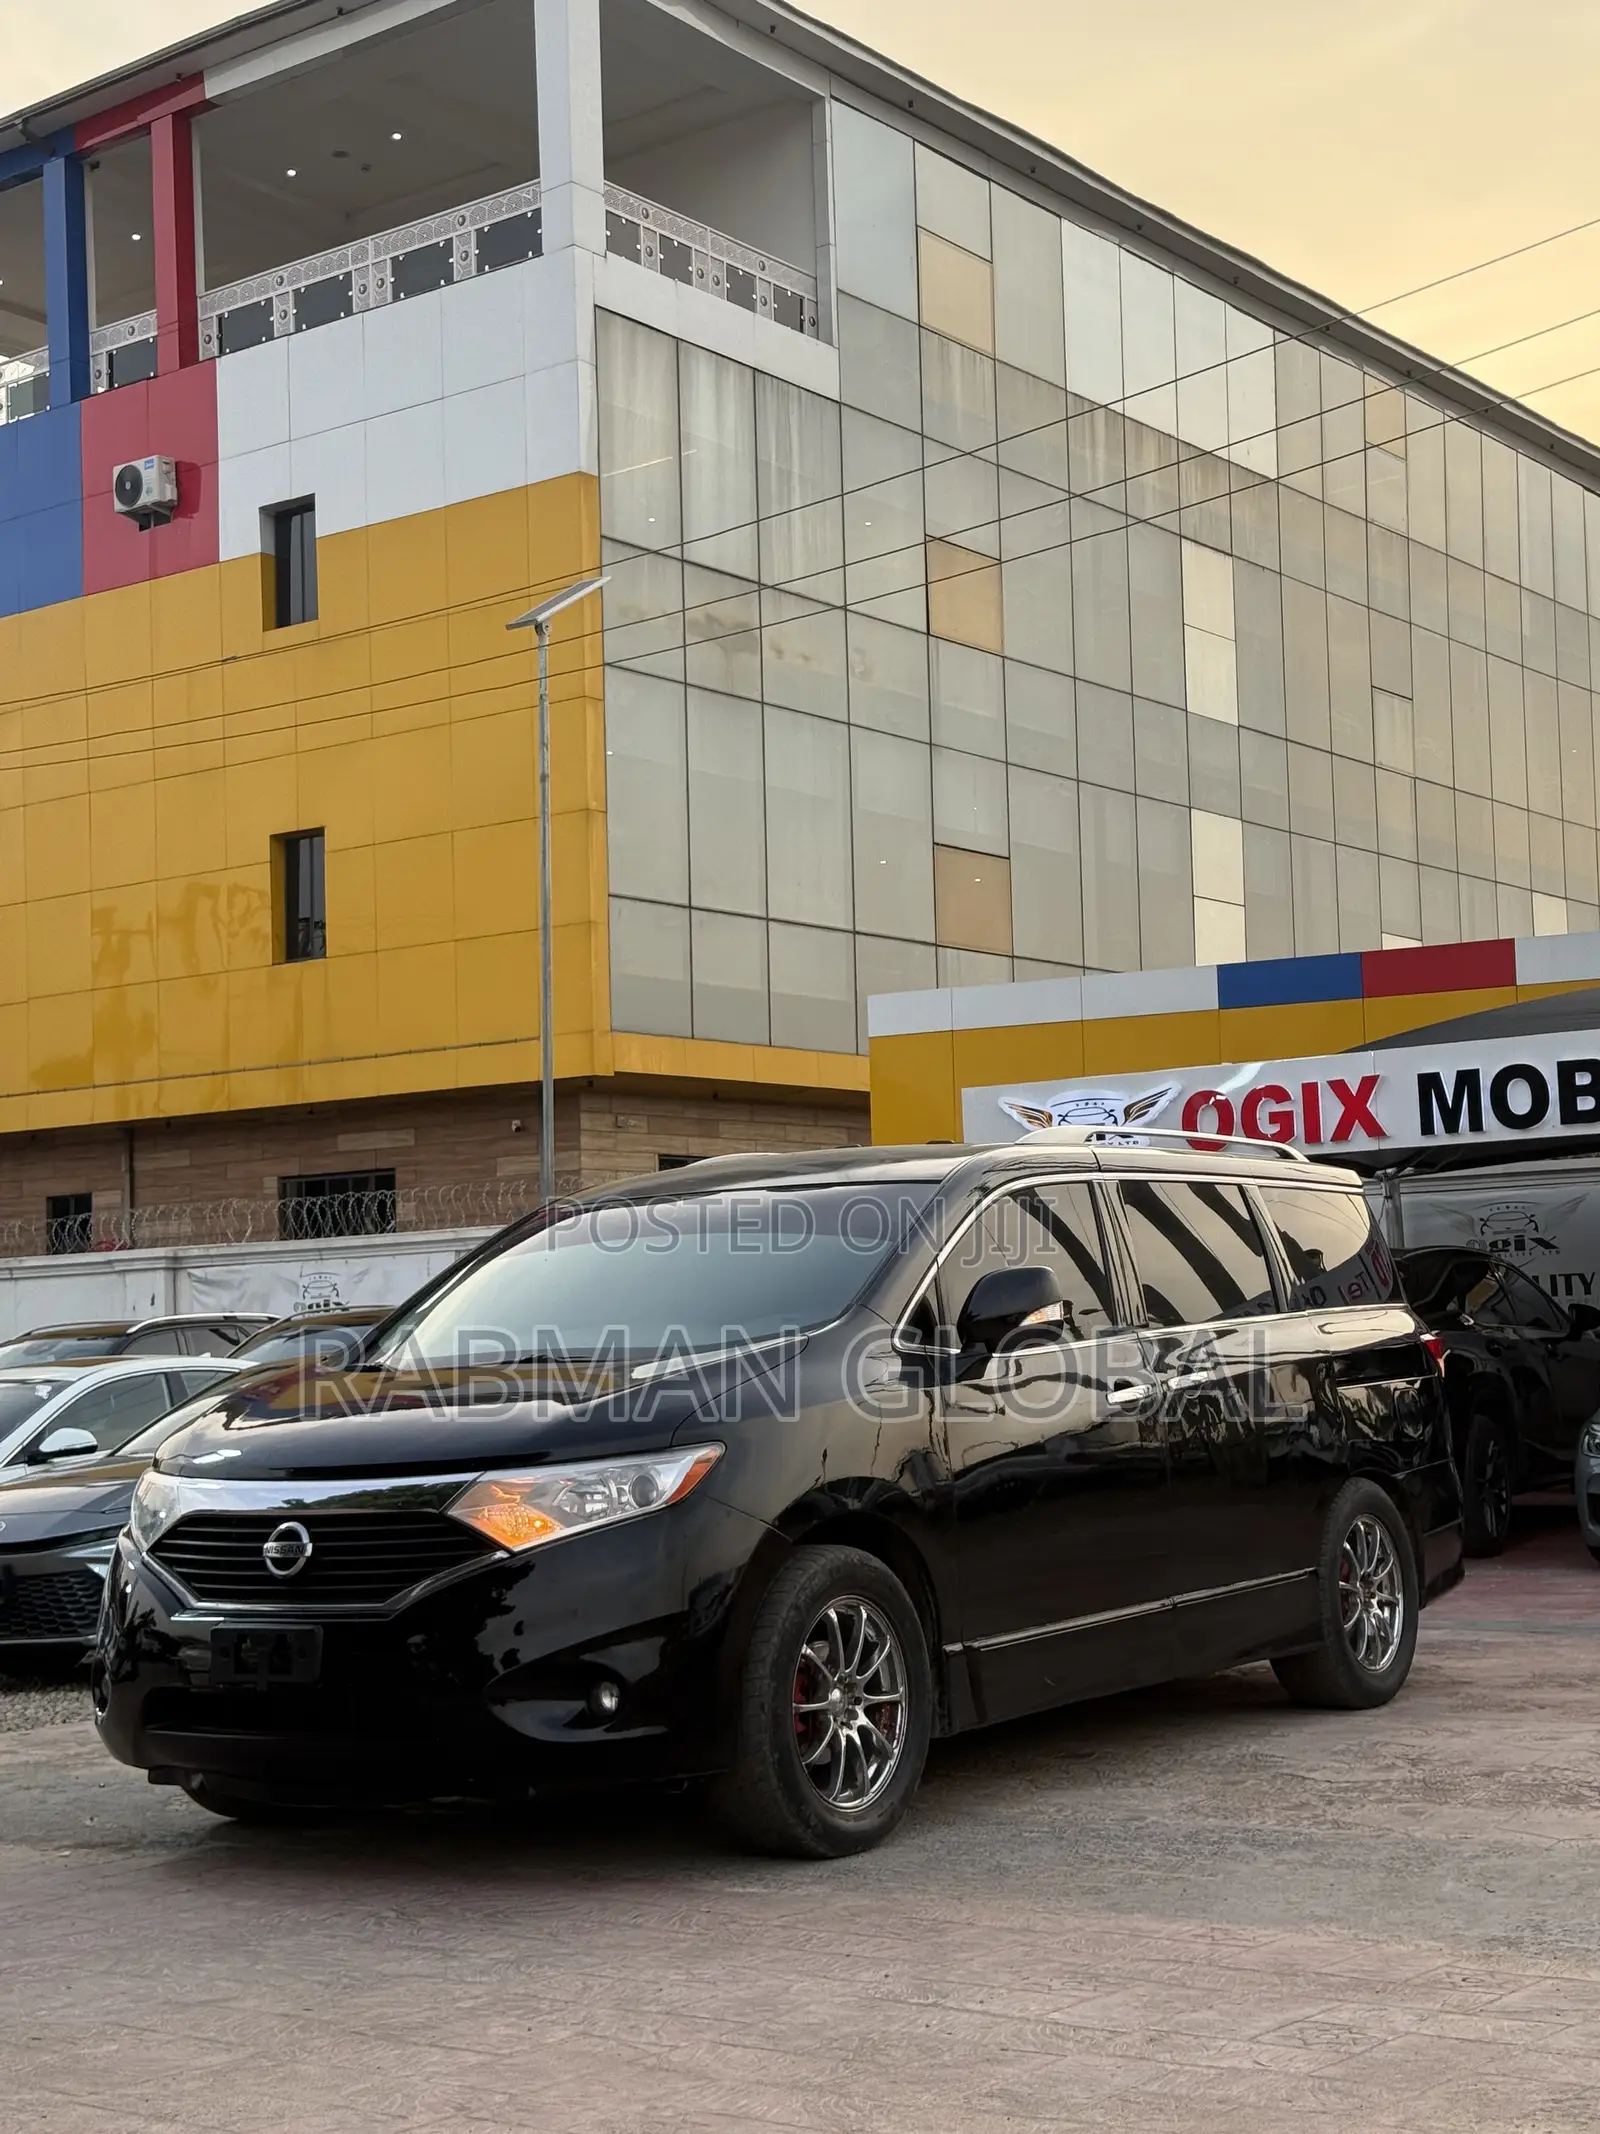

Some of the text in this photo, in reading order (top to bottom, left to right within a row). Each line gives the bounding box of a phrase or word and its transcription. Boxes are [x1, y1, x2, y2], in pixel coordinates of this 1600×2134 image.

[1181, 1058, 1600, 1152] OGIX MOB
[265, 1544, 306, 1556] NISSAN
